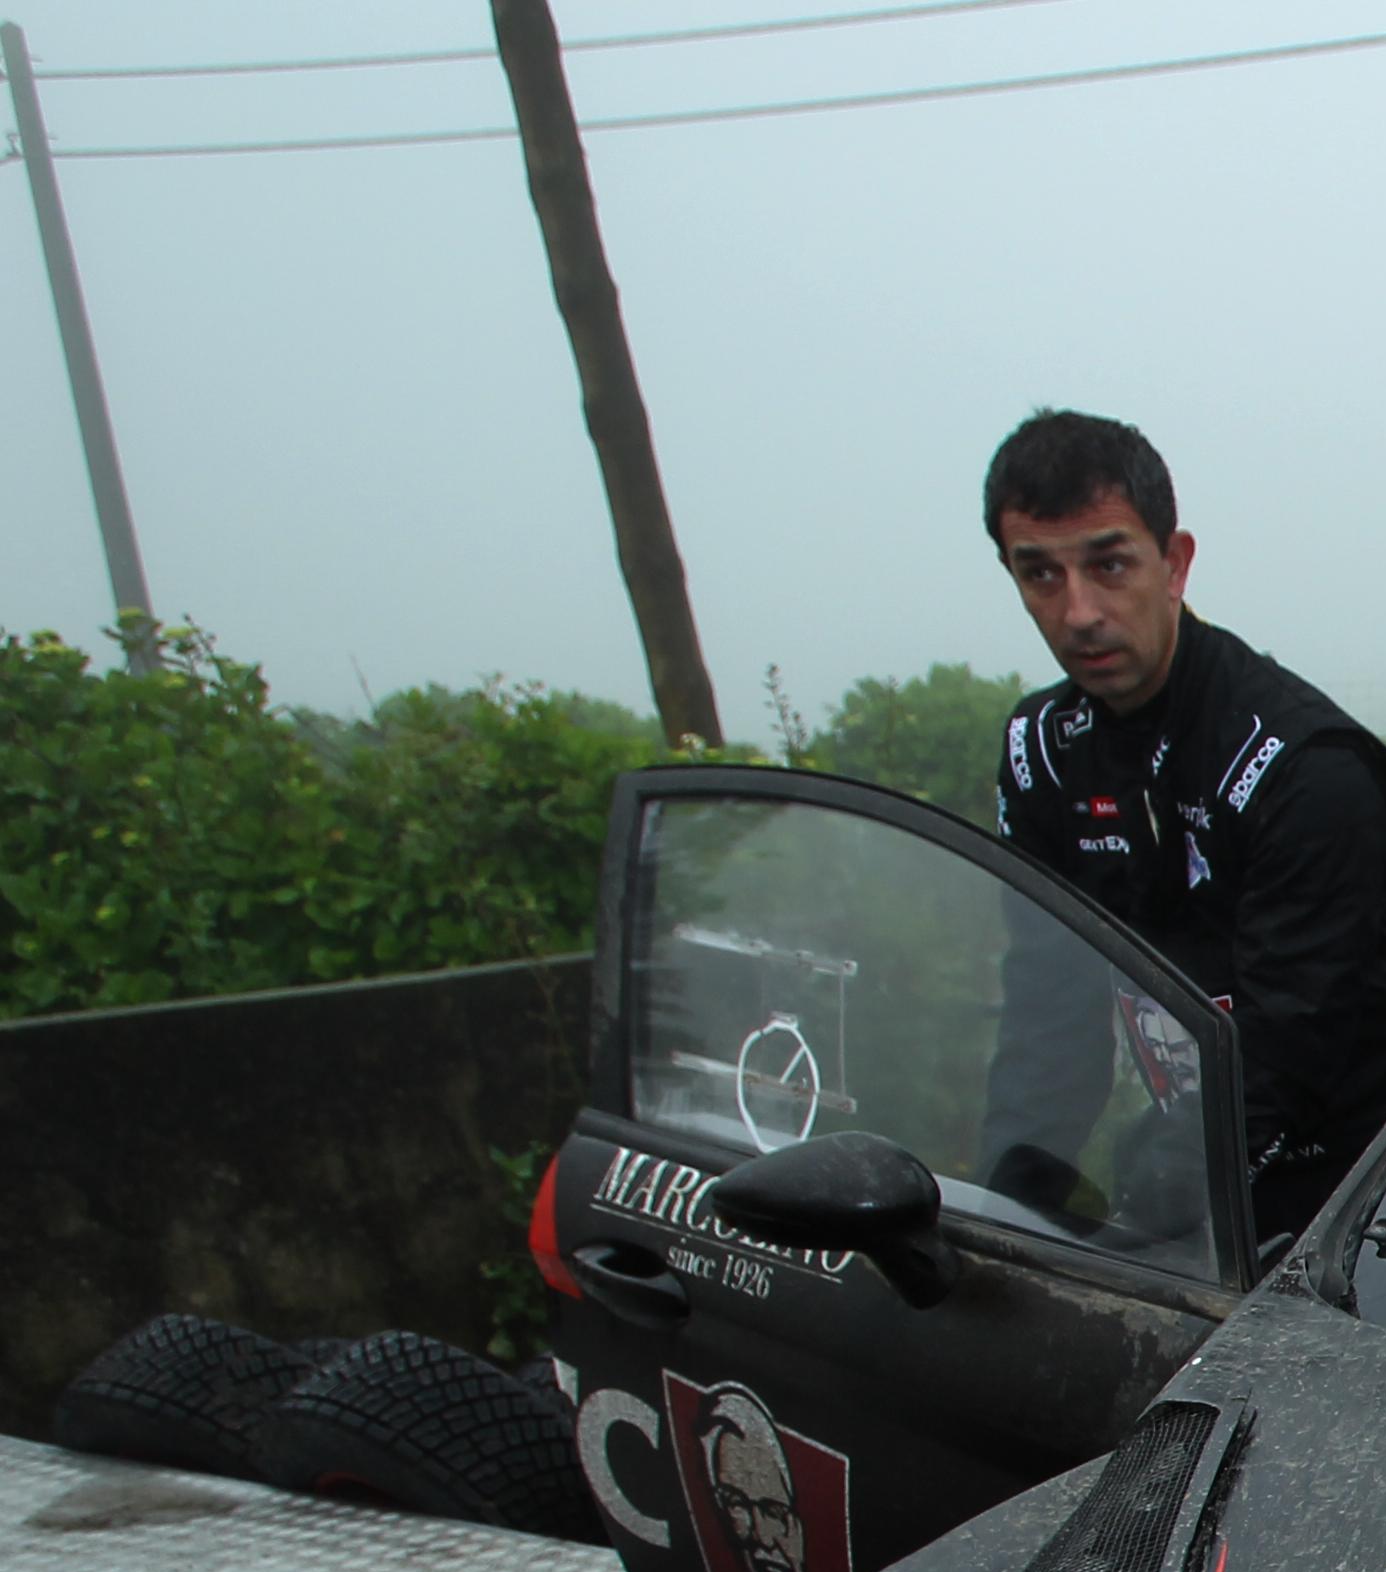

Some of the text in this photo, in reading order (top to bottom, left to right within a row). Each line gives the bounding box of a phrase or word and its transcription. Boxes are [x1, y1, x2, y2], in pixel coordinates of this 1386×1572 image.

[1227, 736, 1283, 811] sparco
[666, 1236, 774, 1299] since 1926
